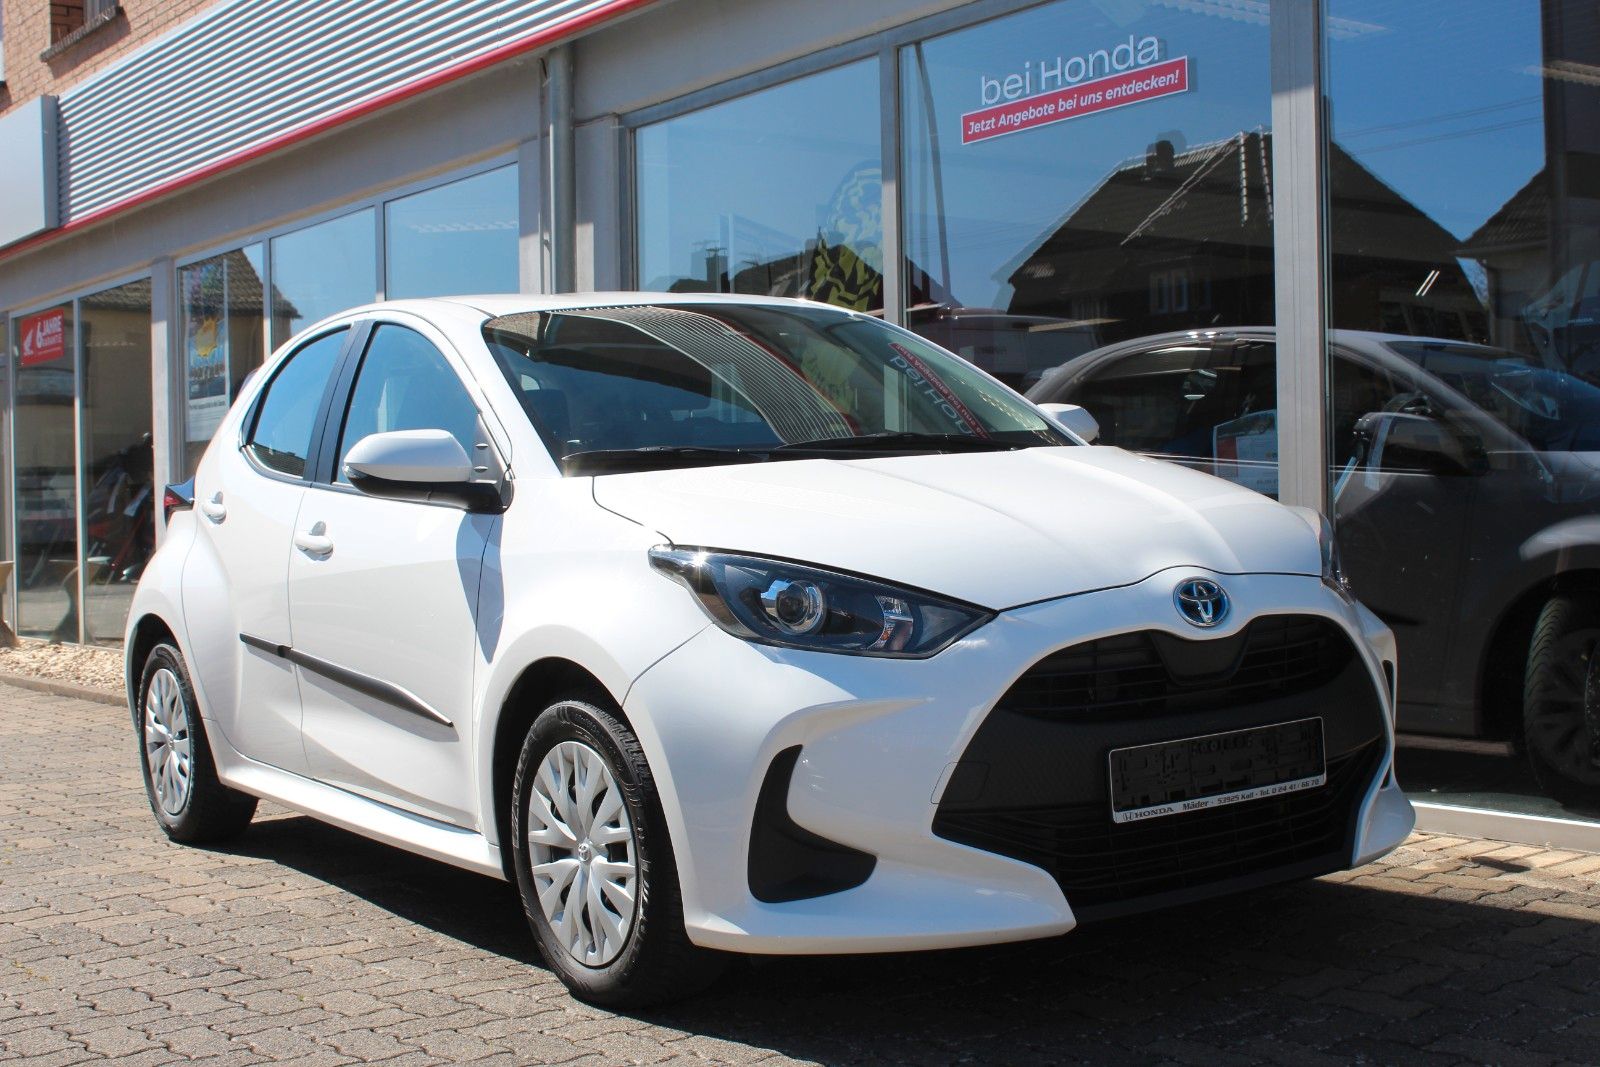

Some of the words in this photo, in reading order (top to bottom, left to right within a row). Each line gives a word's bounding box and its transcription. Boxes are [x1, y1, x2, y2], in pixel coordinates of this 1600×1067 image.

[981, 61, 1030, 105] bei
[1041, 35, 1159, 91] Honda
[968, 116, 996, 135] Jetzt
[999, 104, 1055, 127] Angebote
[1058, 94, 1077, 113] bei
[1080, 93, 1102, 107] uns
[1105, 70, 1180, 100] entdecken!
[43, 316, 62, 337] JAHRE
[1134, 807, 1174, 818] HONDA
[1182, 800, 1209, 811] Mäder
[1217, 795, 1240, 805] 53925
